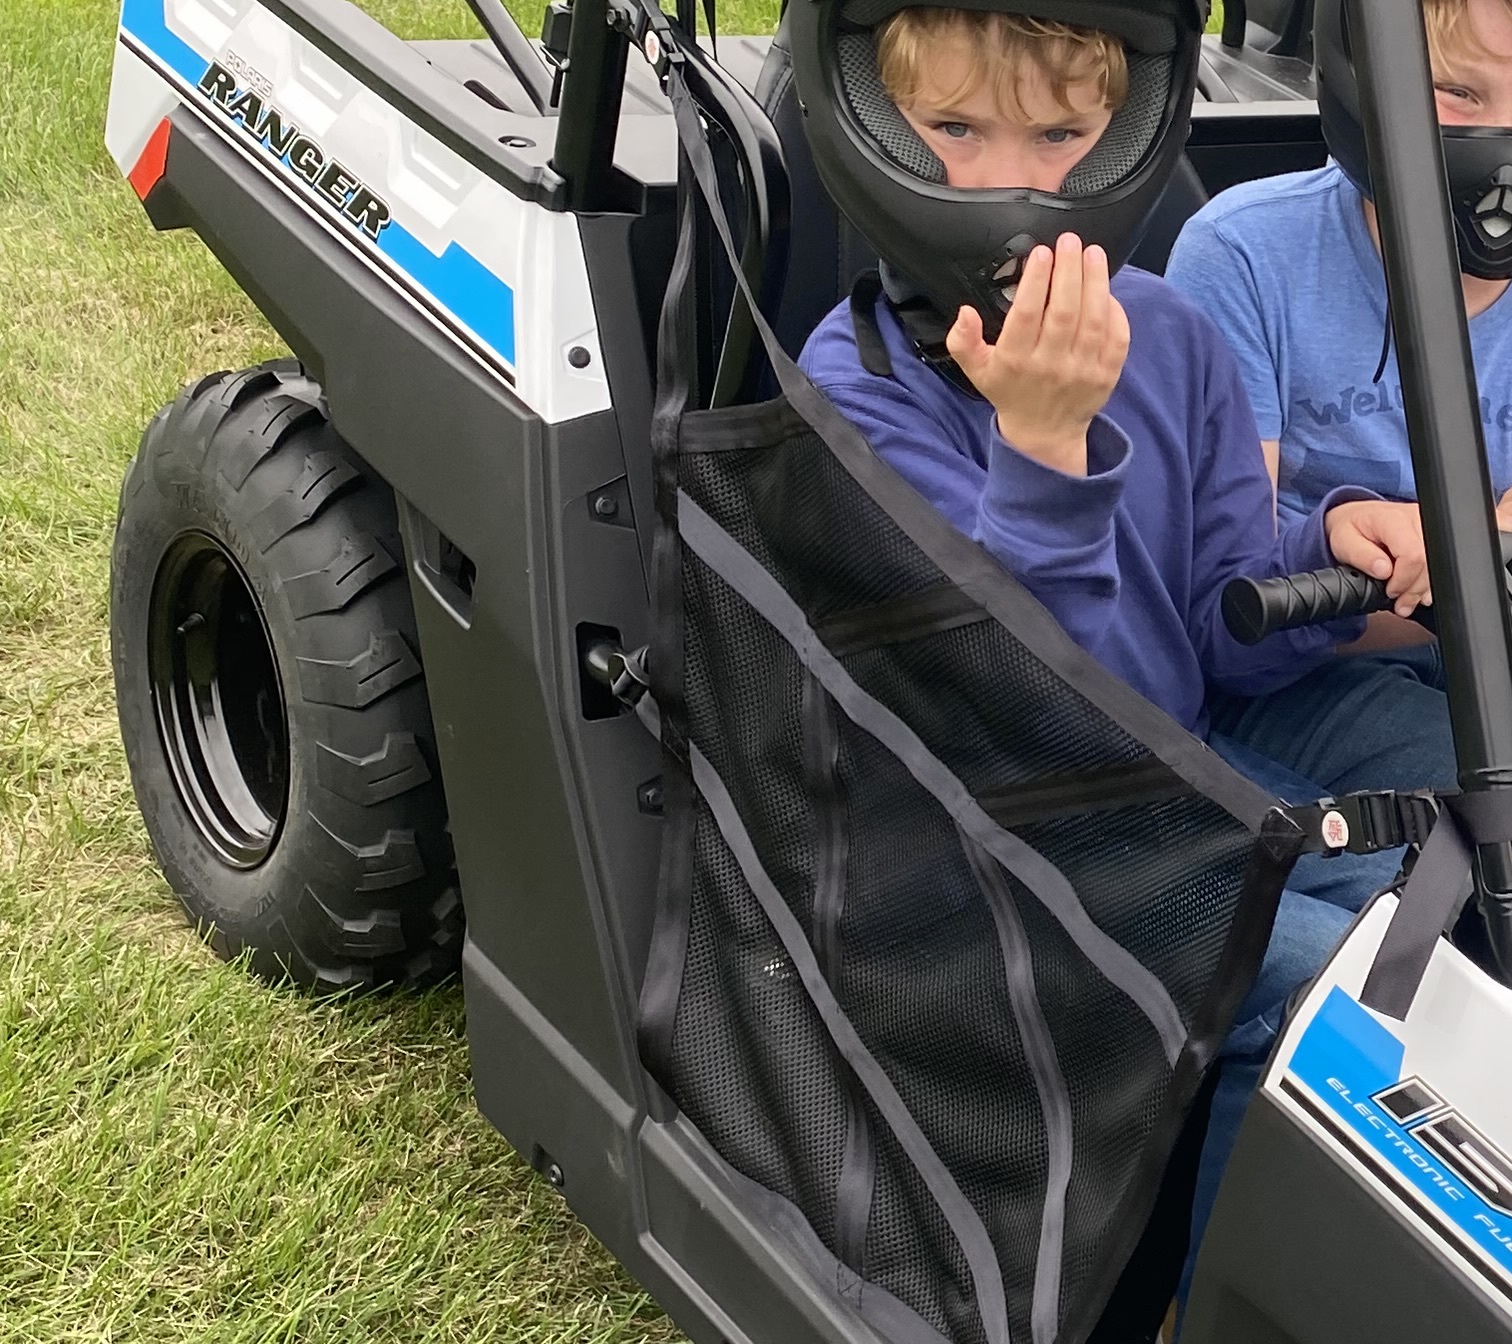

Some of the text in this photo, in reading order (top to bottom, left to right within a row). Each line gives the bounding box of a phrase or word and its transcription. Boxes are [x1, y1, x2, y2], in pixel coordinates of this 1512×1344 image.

[226, 49, 274, 98] POLARIS
[196, 58, 392, 243] RANGER
[1325, 1076, 1466, 1202] ELECTRONIC
